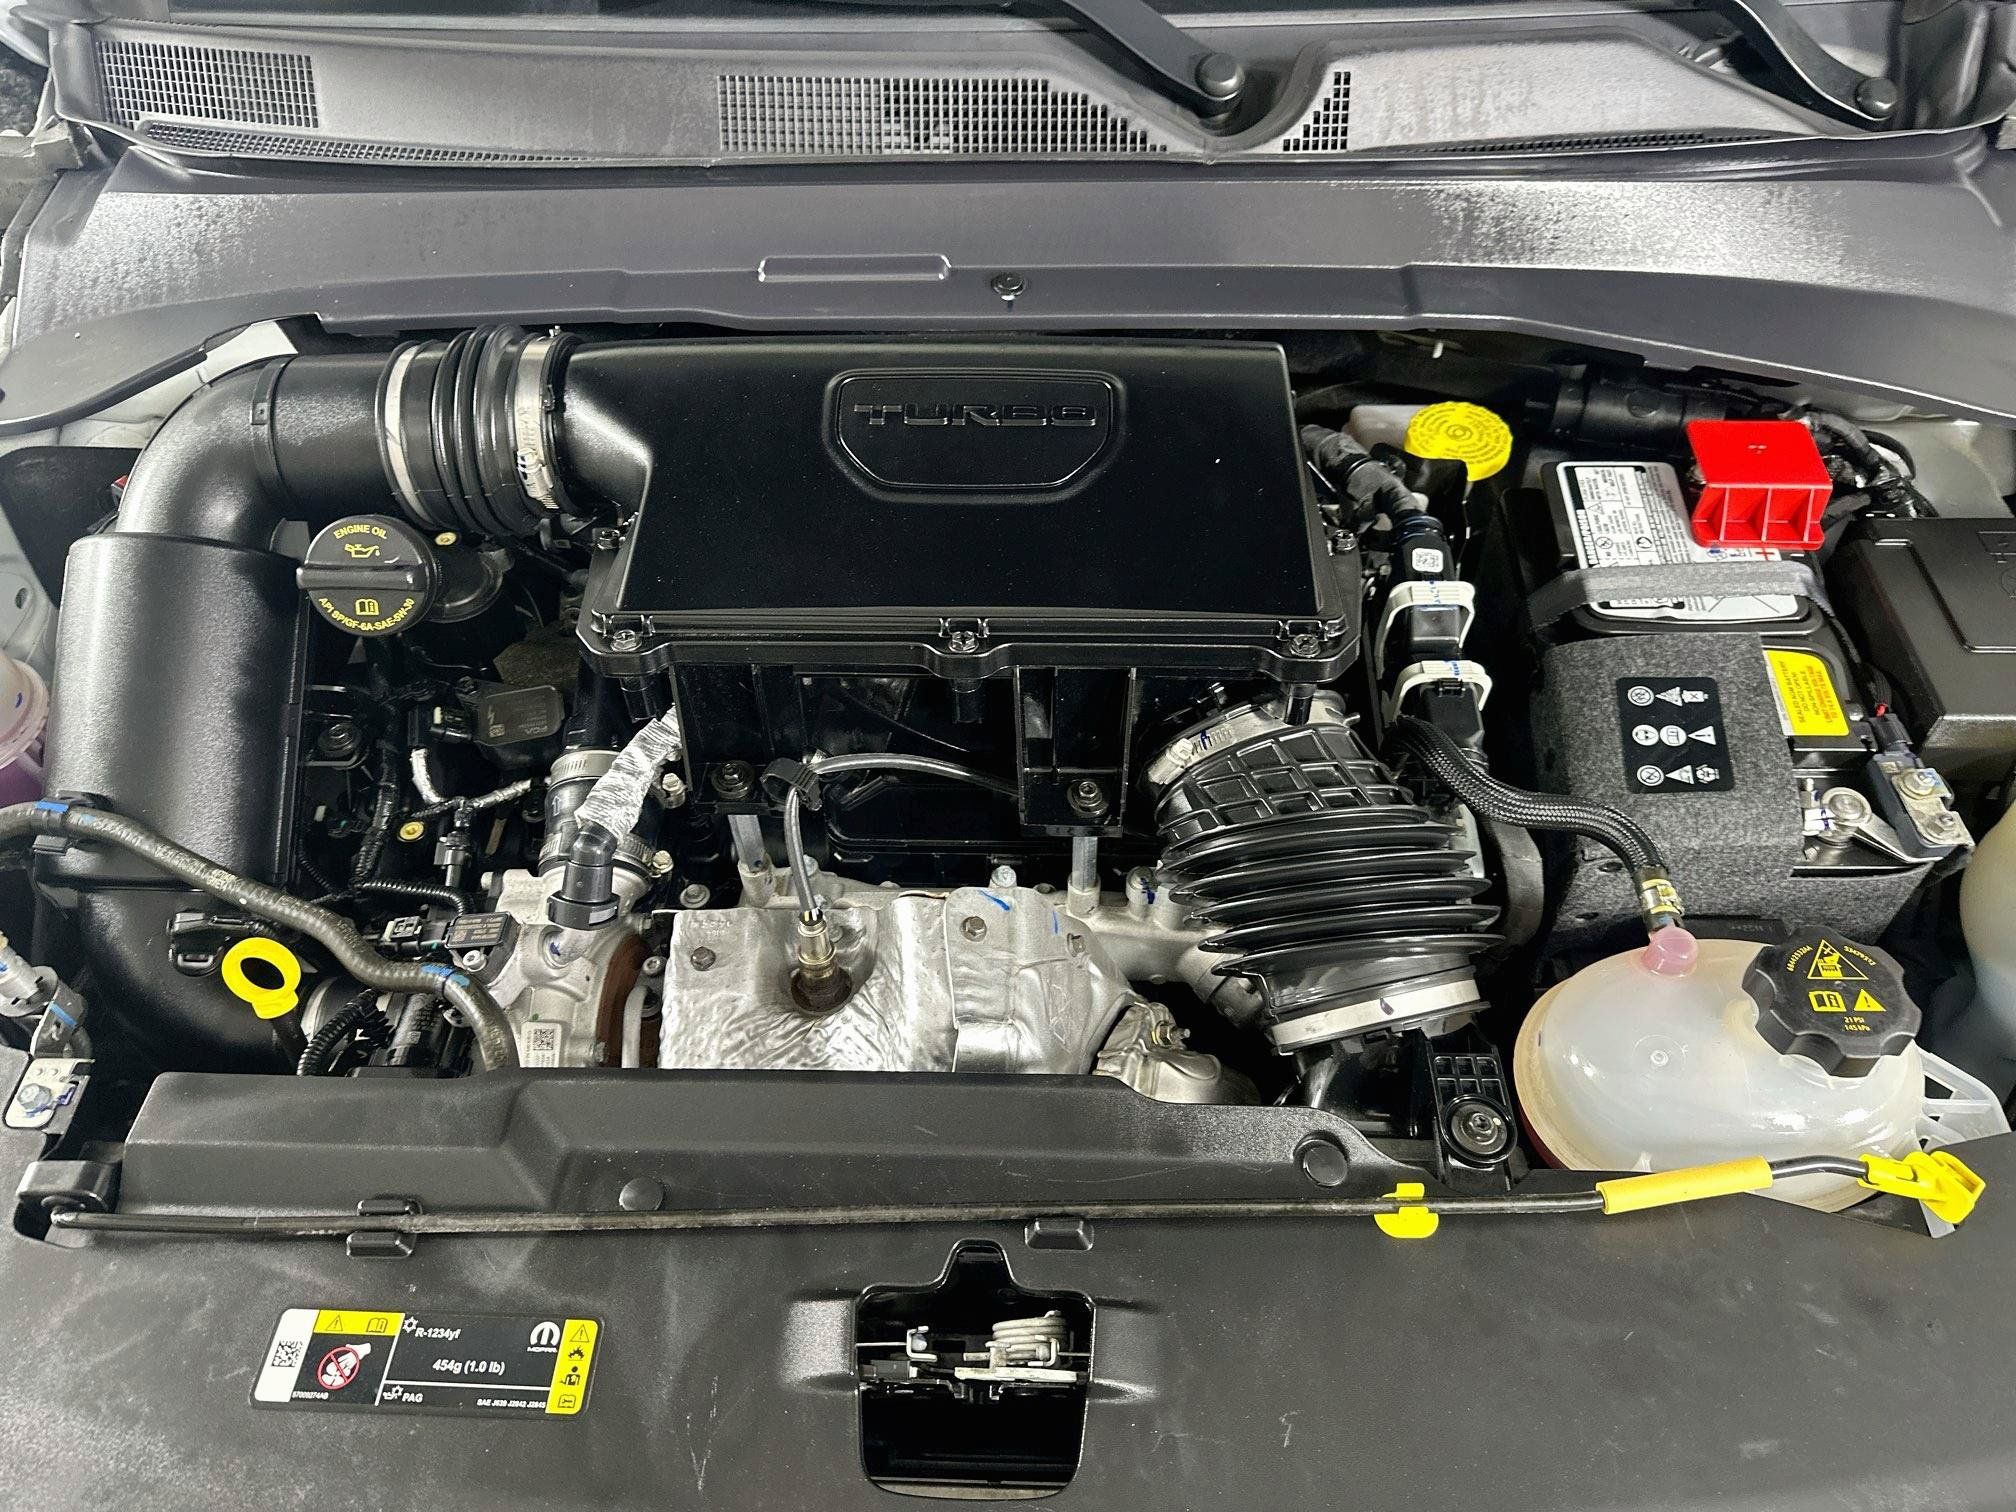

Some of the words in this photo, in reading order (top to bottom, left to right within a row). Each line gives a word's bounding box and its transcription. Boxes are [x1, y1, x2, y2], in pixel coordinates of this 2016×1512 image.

[854, 404, 1096, 426] TURBO
[333, 524, 371, 540] ENGINE
[371, 526, 388, 540] OIL
[318, 597, 335, 613] API
[415, 1327, 461, 1341] R-1234yf
[432, 1359, 462, 1374] 454g
[464, 1360, 487, 1374] (1.0
[488, 1361, 505, 1375] lb)
[402, 1392, 423, 1403] PAG
[476, 1398, 491, 1406] SAE
